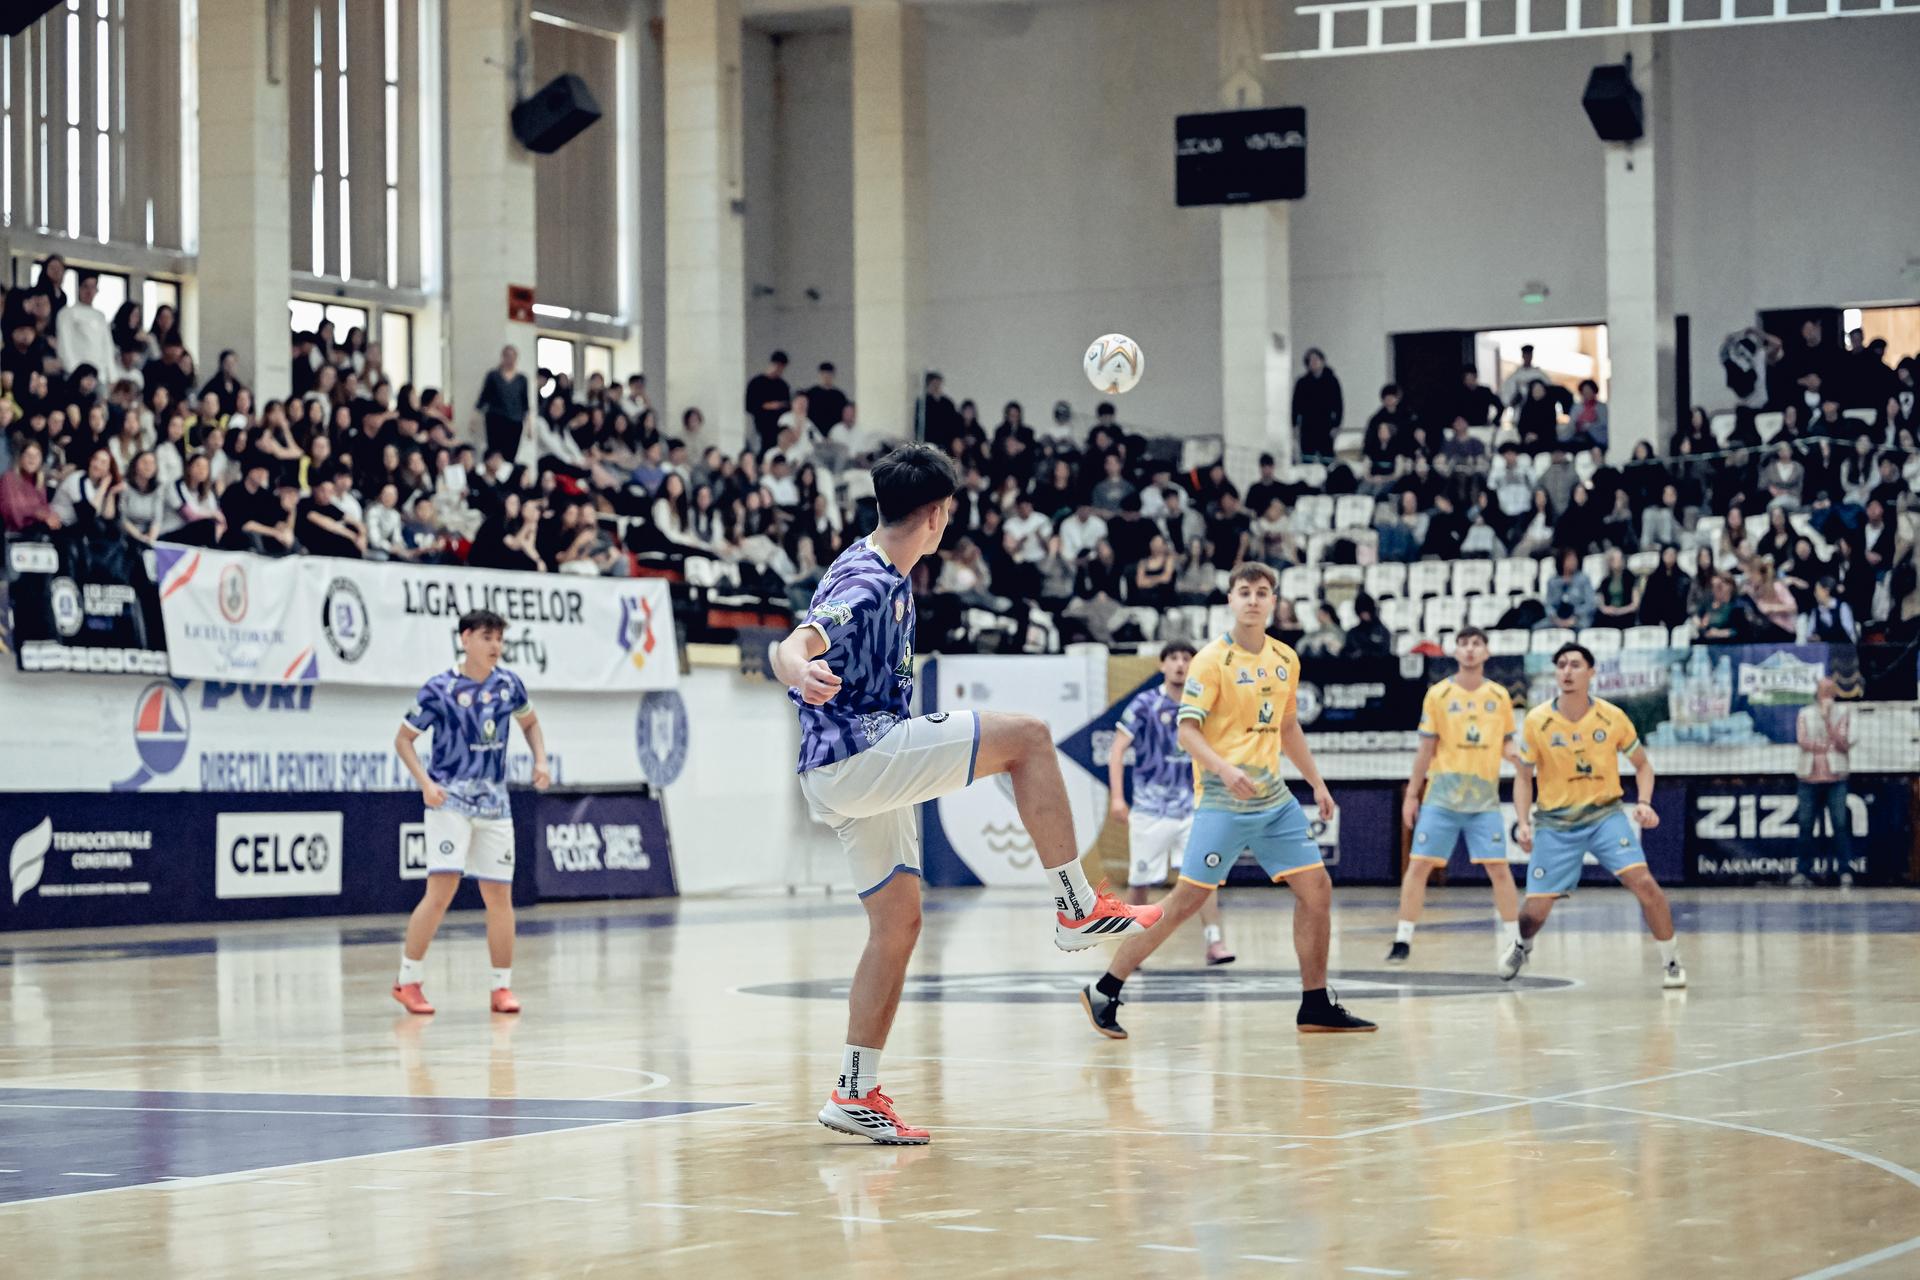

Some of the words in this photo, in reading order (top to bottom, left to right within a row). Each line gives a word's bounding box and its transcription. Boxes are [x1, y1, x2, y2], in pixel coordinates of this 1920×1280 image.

[403, 580, 461, 618] LIGA
[466, 584, 584, 624] LICEELOR
[231, 833, 330, 874] CELCO
